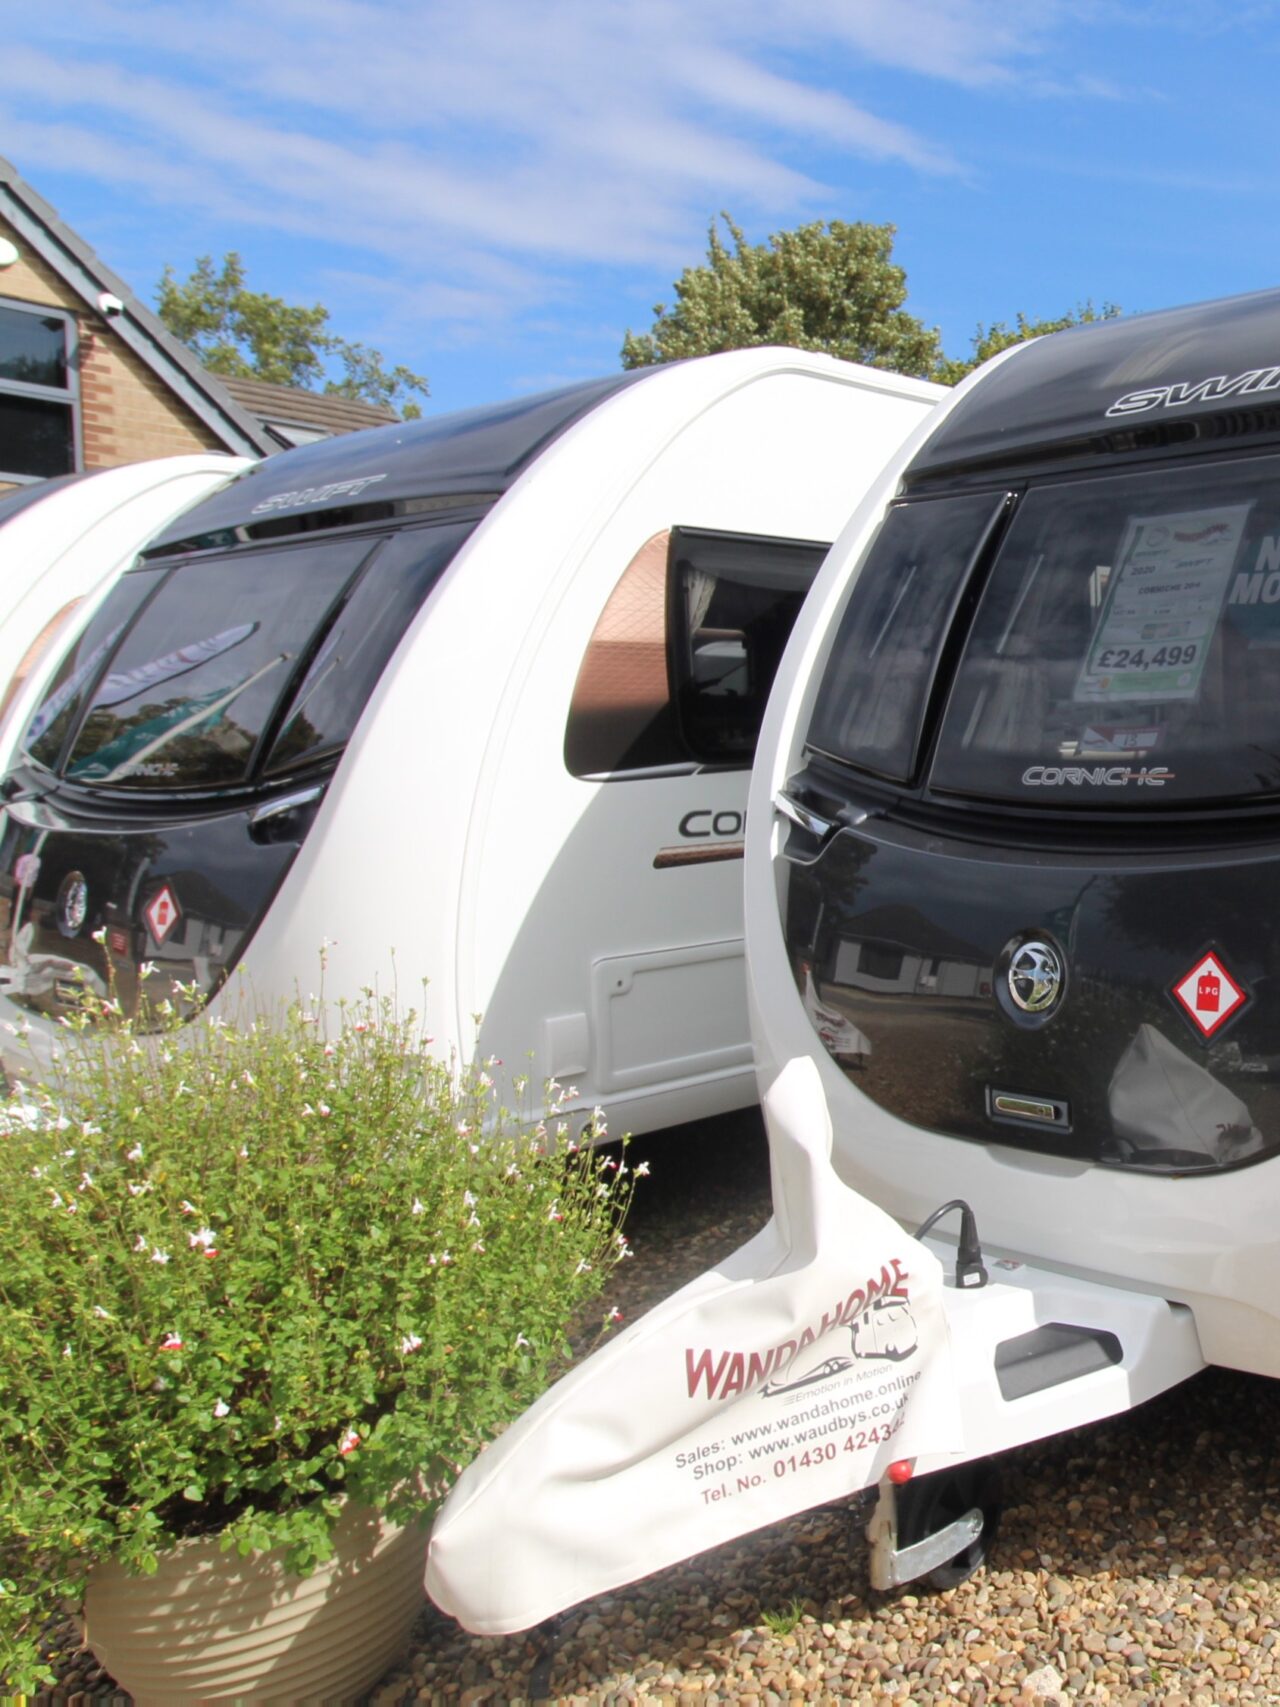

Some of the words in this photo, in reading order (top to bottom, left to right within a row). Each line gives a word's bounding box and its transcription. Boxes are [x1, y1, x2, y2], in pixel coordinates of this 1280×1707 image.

[251, 473, 388, 514] SWIFT
[1130, 565, 1156, 575] 2020
[1138, 584, 1181, 595] CORNICHE
[1097, 644, 1196, 671] £24,499
[1022, 766, 1172, 786] CORNICHE
[678, 809, 747, 838] CO
[1198, 985, 1219, 996] LPG
[685, 1258, 909, 1400] WANDAHOME
[791, 1382, 841, 1403] Emotion
[844, 1376, 854, 1388] in
[855, 1364, 893, 1384] Motion
[675, 1439, 726, 1469] Sales:
[730, 1369, 922, 1446] www.wandahome.online
[693, 1451, 743, 1480] Shop:
[748, 1393, 910, 1460] www.waudbys.co.uk
[700, 1483, 732, 1505] Tel.
[737, 1475, 767, 1493] No.
[773, 1442, 837, 1478] 01430
